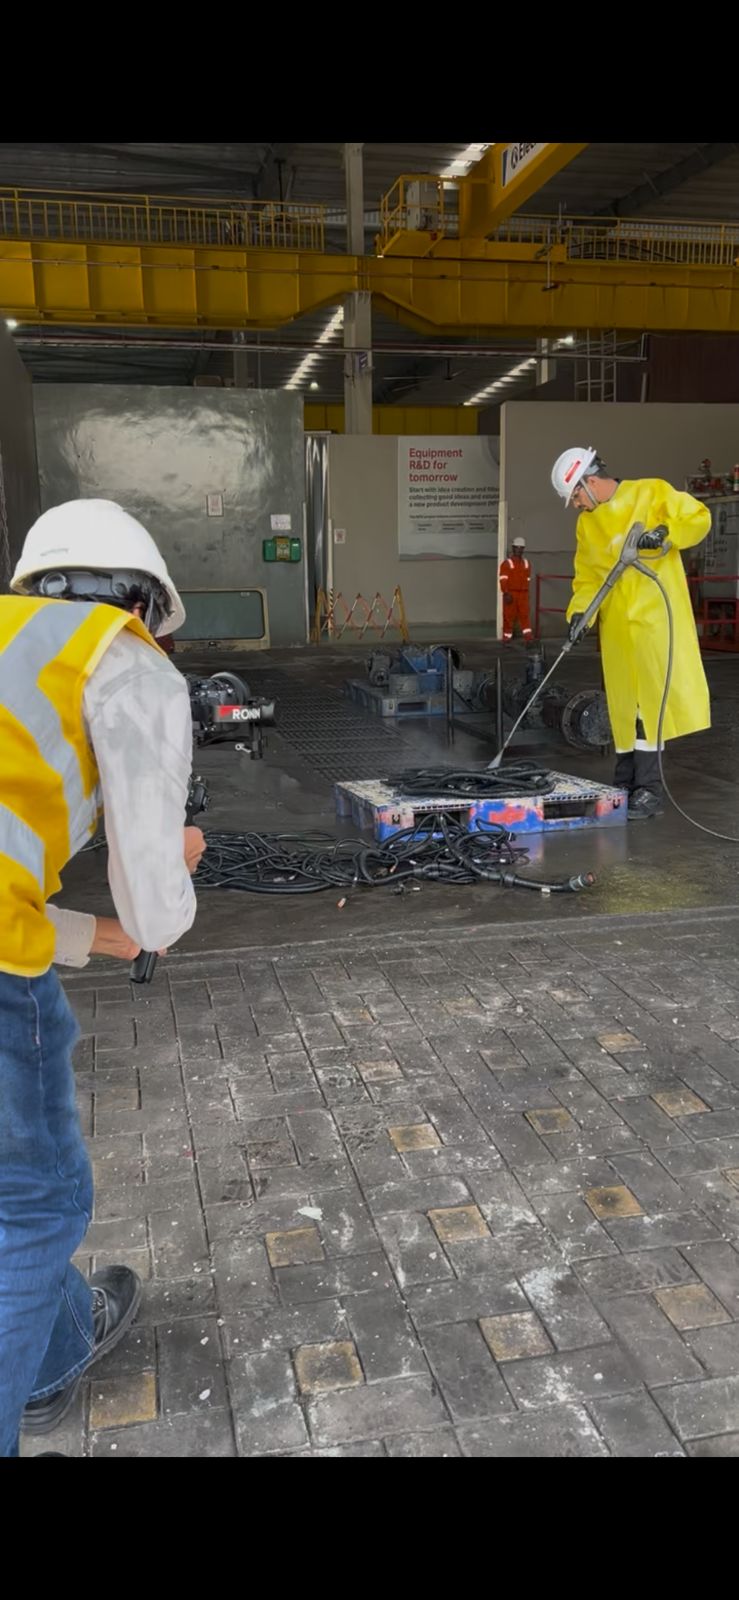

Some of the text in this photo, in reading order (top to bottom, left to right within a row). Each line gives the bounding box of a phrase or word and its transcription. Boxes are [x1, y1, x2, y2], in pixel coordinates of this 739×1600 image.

[409, 448, 463, 459] Equipment
[409, 460, 448, 470] R&D for
[409, 473, 458, 482] tomorrow
